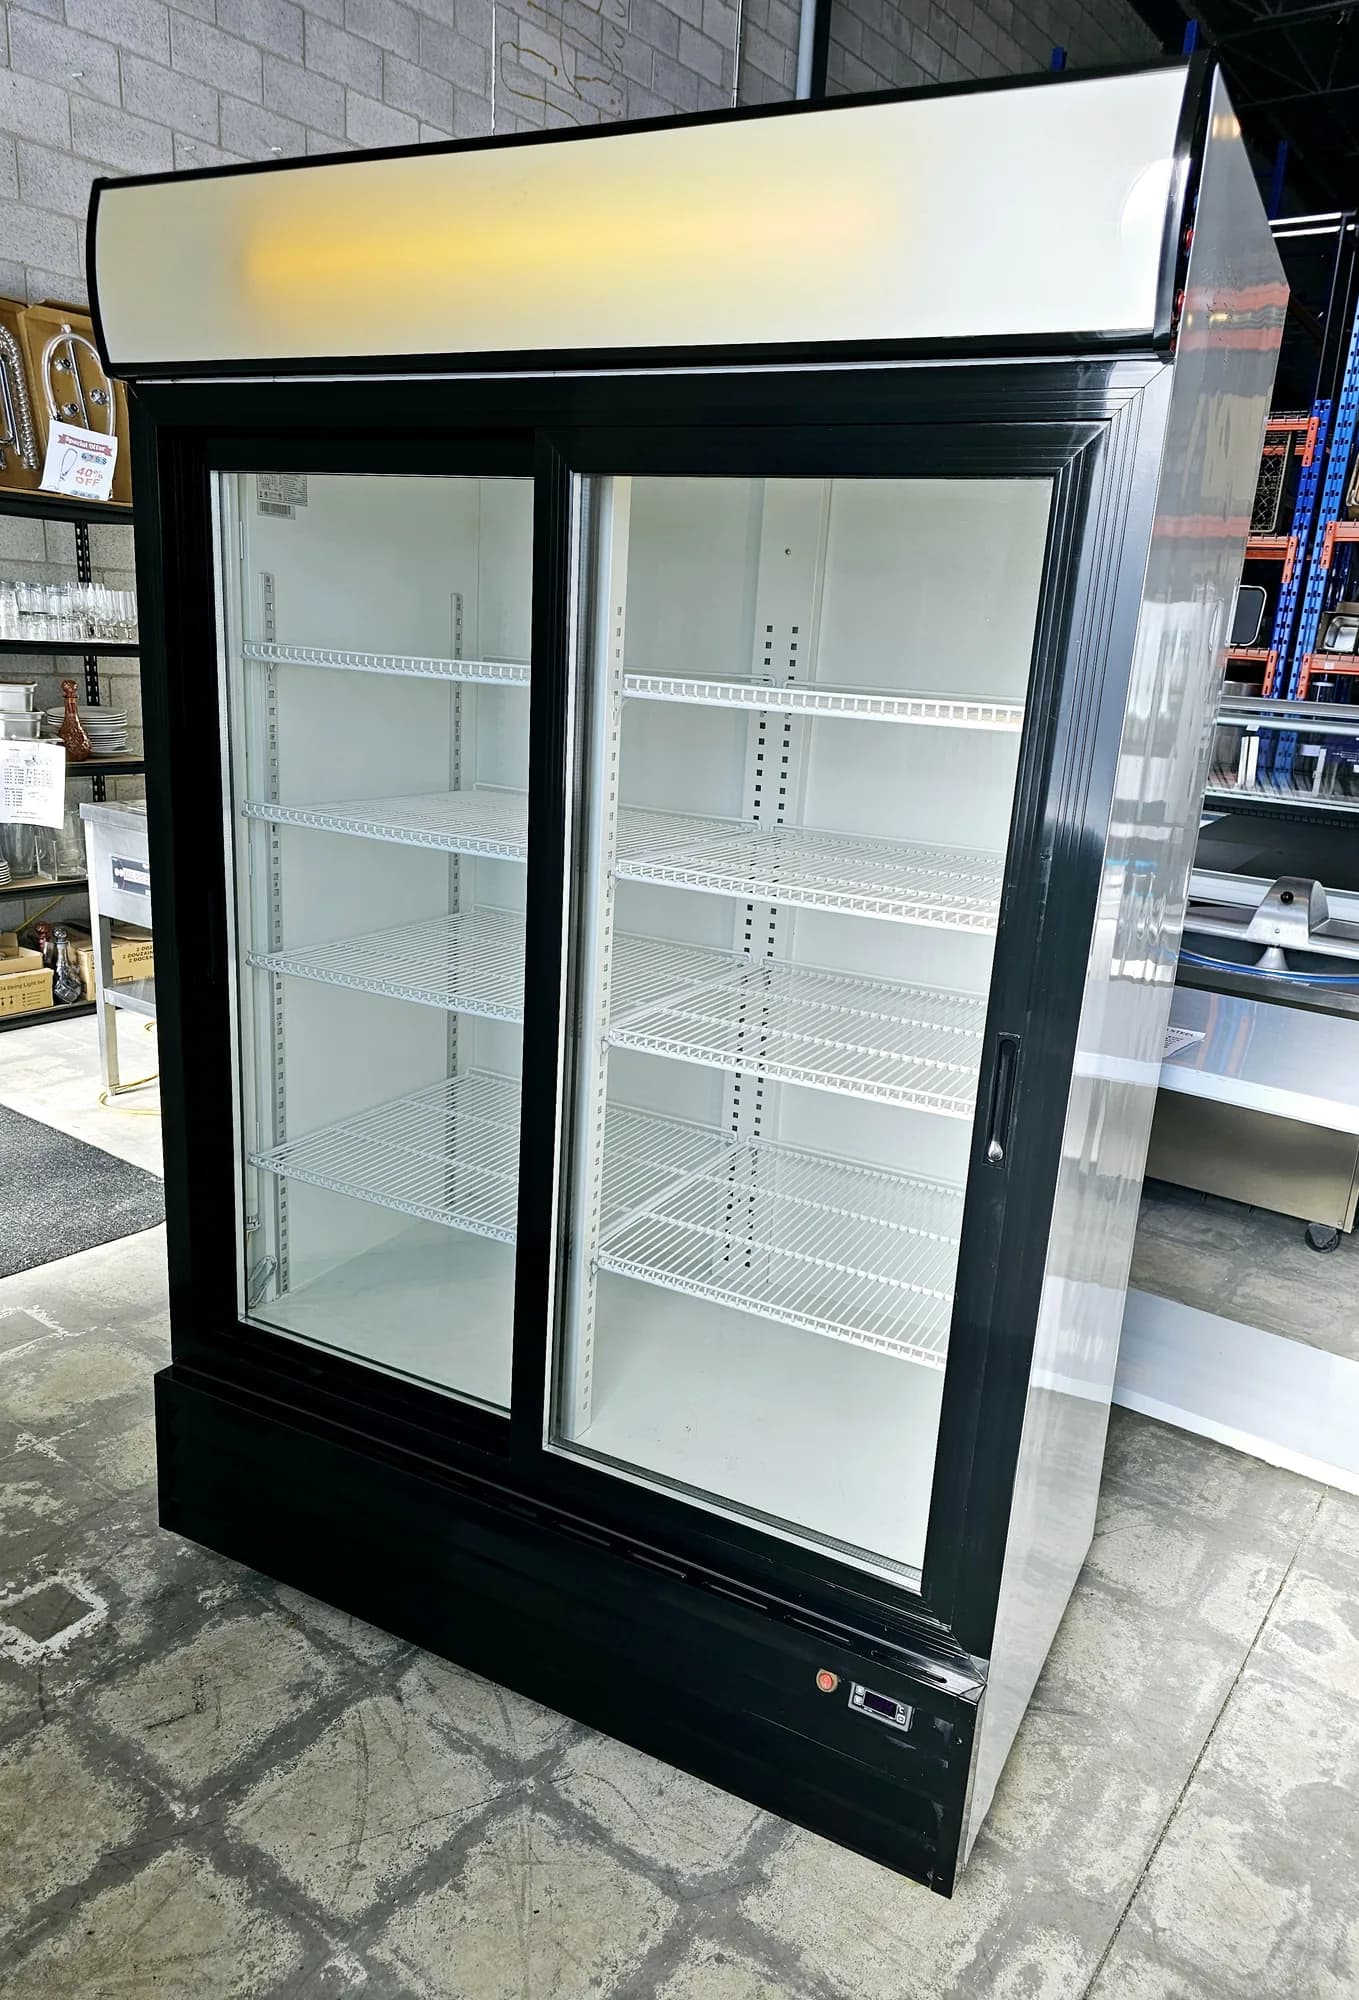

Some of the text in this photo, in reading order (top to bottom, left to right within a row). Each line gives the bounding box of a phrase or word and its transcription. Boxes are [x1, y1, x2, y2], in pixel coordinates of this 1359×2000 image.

[65, 436, 88, 449] Special
[77, 467, 103, 479] 40%
[75, 476, 100, 486] OFF
